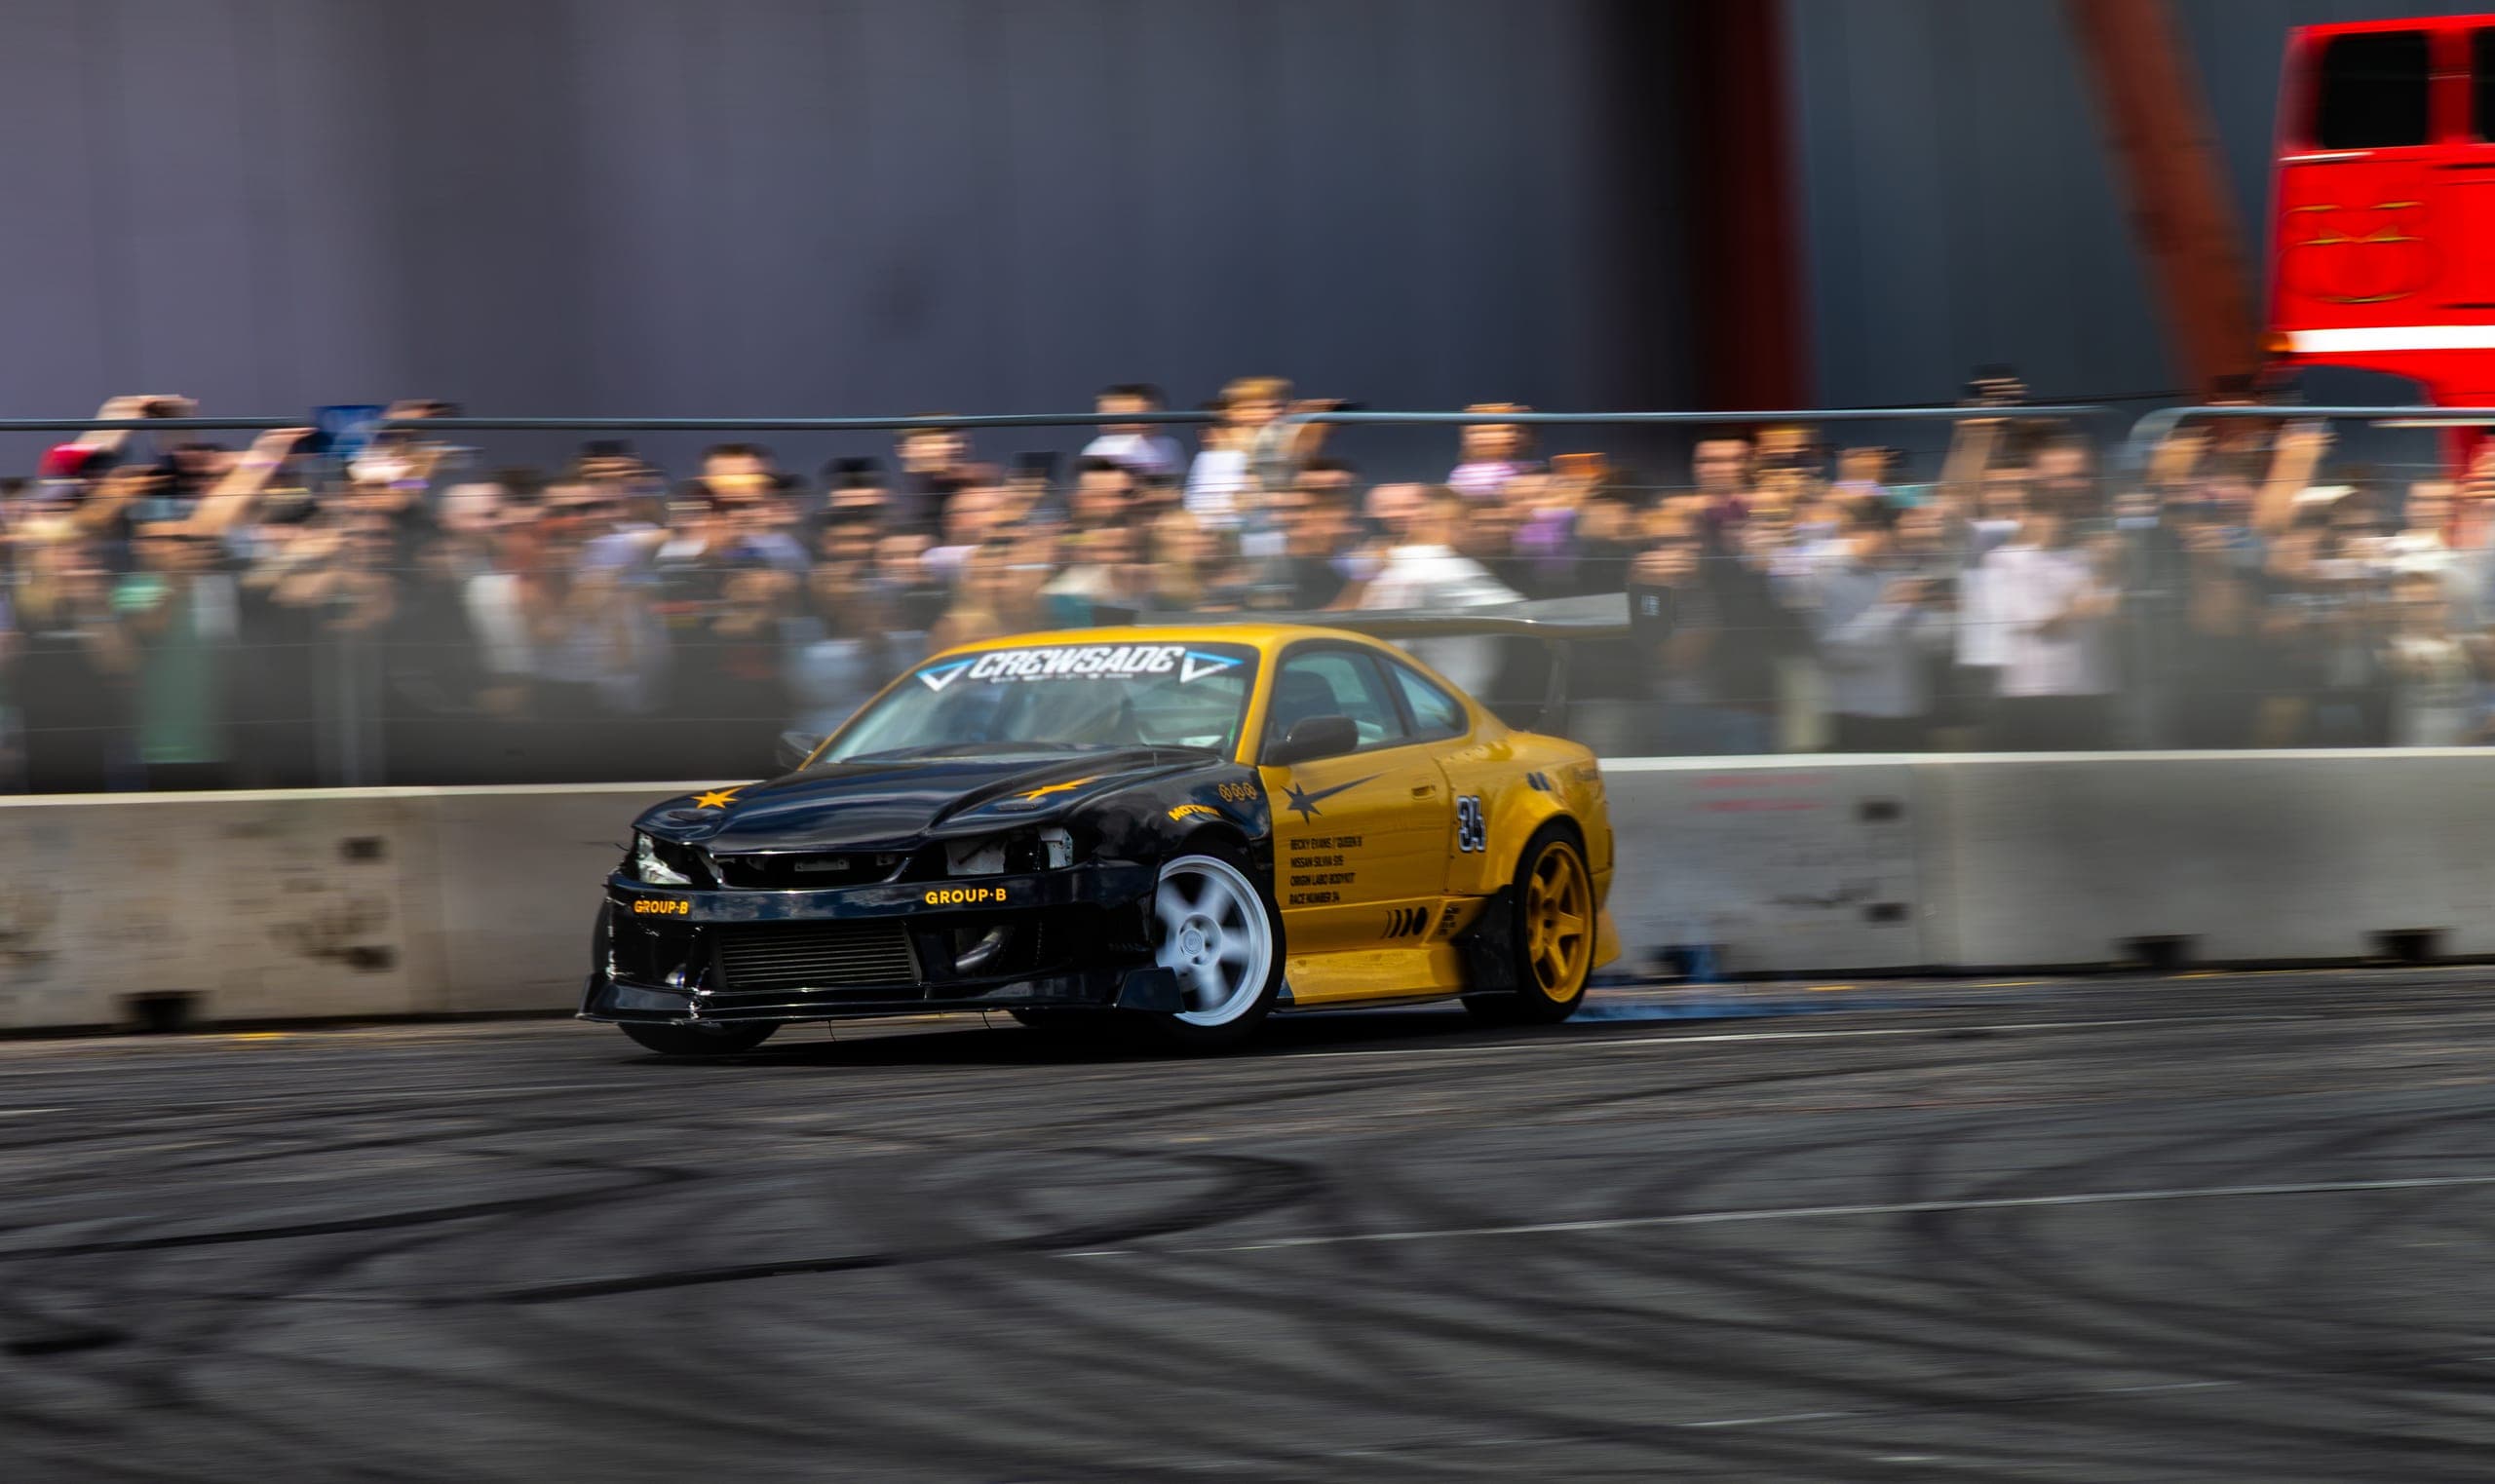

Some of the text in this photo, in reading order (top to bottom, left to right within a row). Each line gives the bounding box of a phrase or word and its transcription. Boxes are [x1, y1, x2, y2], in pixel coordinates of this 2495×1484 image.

[968, 646, 1186, 679] CREWSADE
[1456, 795, 1486, 853] 34
[1290, 857, 1313, 868] NISSAN
[1289, 893, 1305, 904] RACE
[1306, 891, 1331, 903] NUMBER
